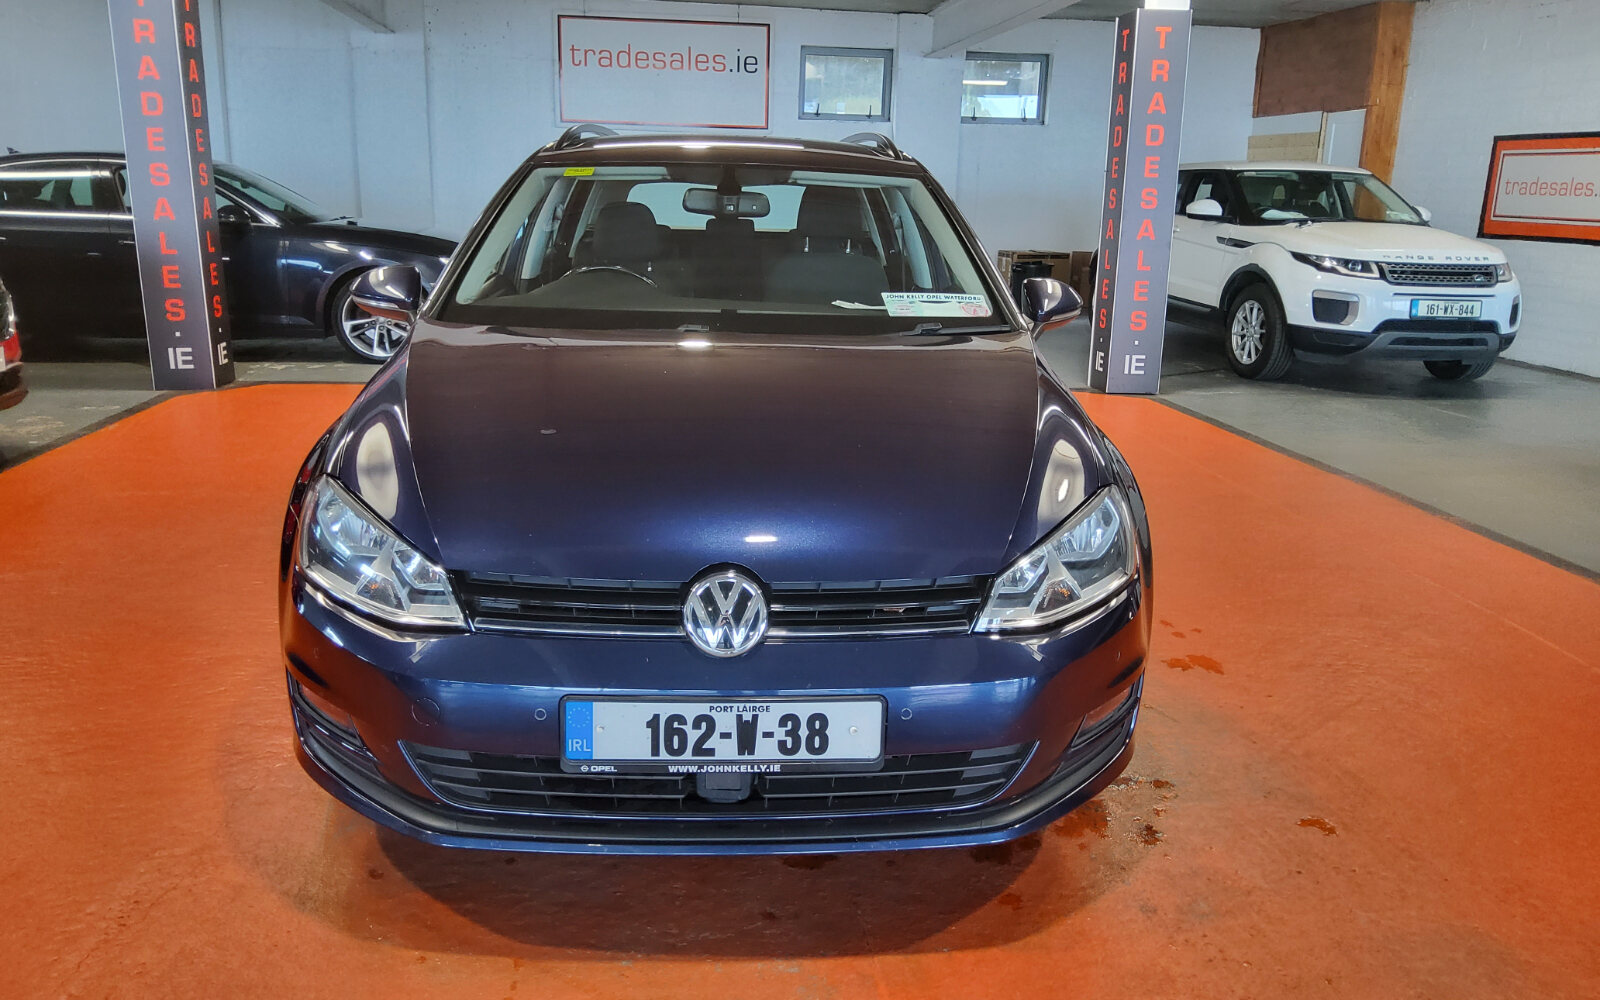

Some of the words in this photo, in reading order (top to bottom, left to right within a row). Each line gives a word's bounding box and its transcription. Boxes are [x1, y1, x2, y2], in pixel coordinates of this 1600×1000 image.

[569, 43, 758, 74] tradesales.ie
[1505, 176, 1600, 197] tradesales.
[1426, 303, 1475, 316] 161-WX-844
[709, 705, 734, 713] PORT
[737, 704, 771, 713] LÁIRGE
[645, 712, 830, 757] 162-W-38
[568, 739, 592, 752] IRL
[668, 764, 781, 773] WWW.JOHNKELLY.IE
